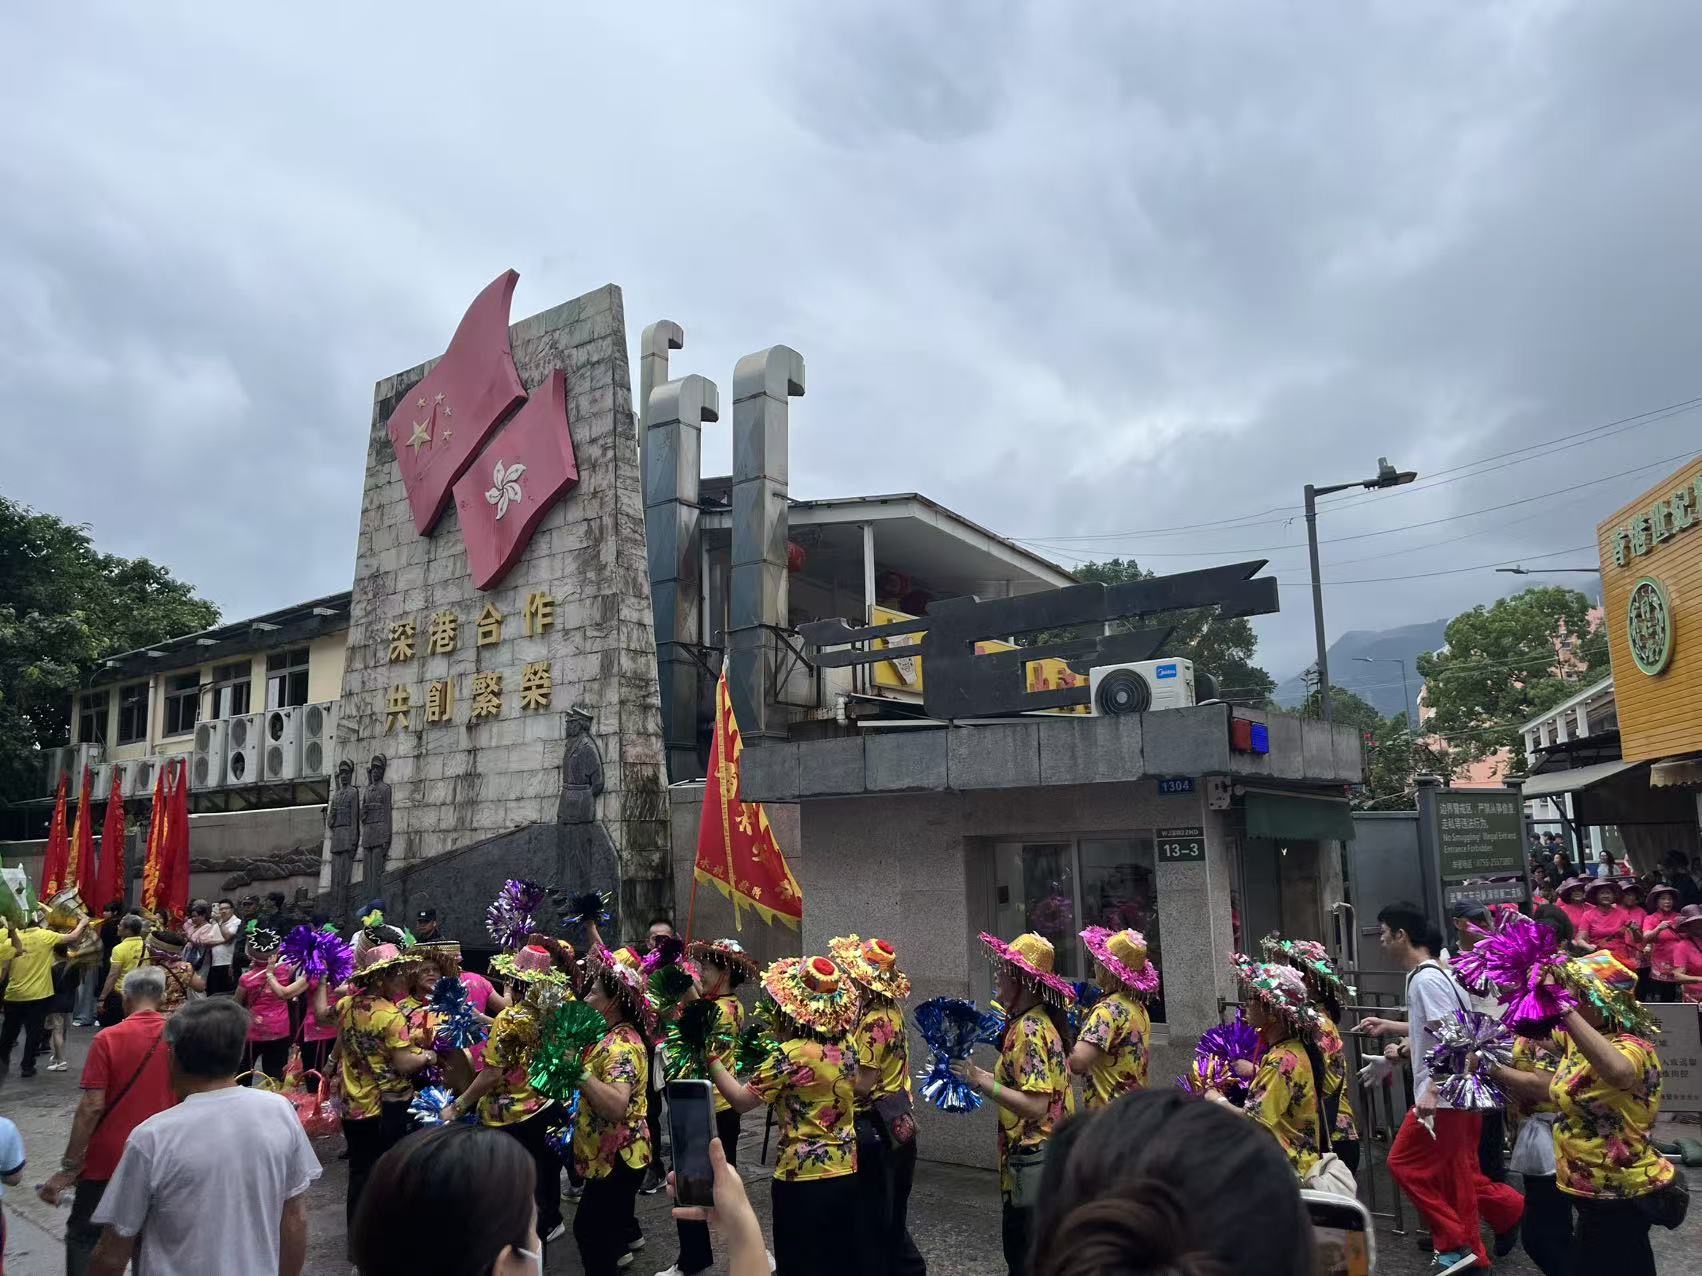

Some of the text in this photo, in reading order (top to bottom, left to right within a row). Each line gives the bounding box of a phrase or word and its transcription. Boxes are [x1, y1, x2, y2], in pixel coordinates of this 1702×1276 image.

[388, 591, 556, 665] 深港合作
[383, 660, 553, 738] 共創繁榮
[1161, 780, 1190, 792] 1304
[1443, 833, 1451, 842] No
[1163, 842, 1199, 857] 13-3
